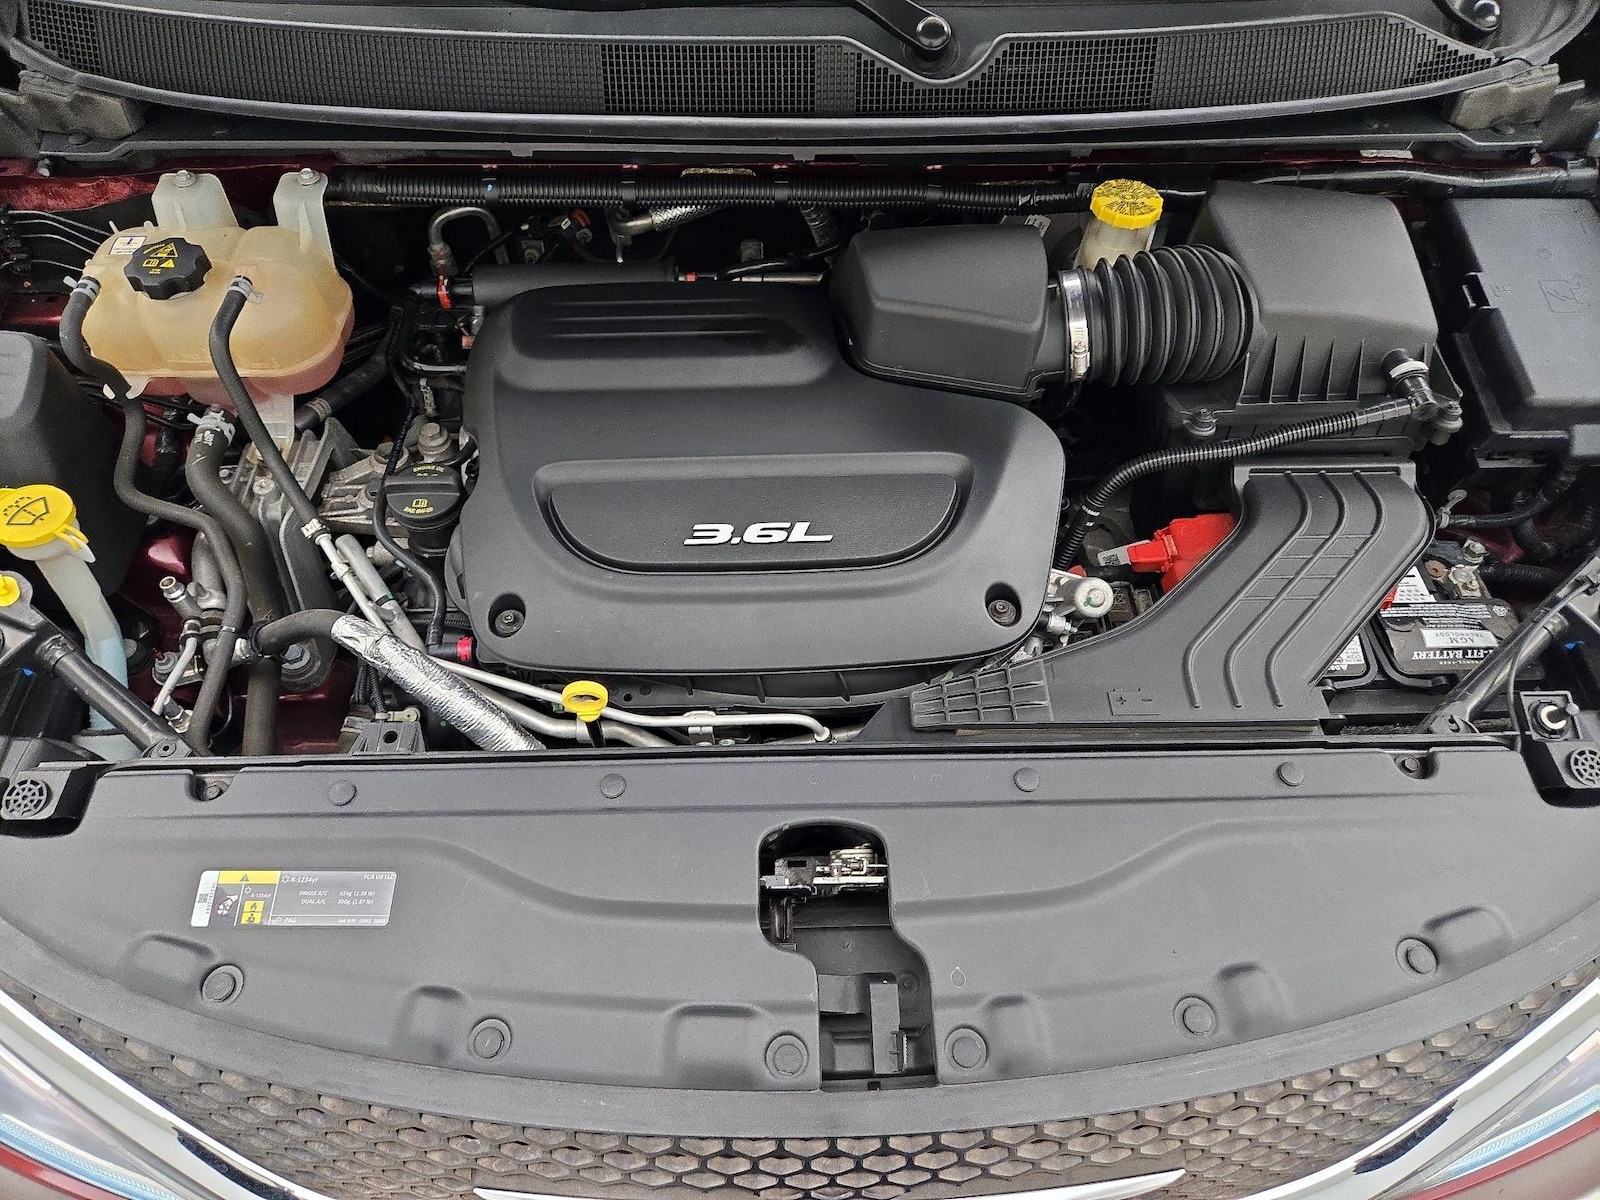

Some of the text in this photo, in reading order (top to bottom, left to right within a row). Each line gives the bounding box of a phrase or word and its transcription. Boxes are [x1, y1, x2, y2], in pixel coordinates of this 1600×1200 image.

[684, 522, 834, 545] 3.6L
[1411, 650, 1463, 660] BATTERY
[290, 876, 319, 884] R-1234yf
